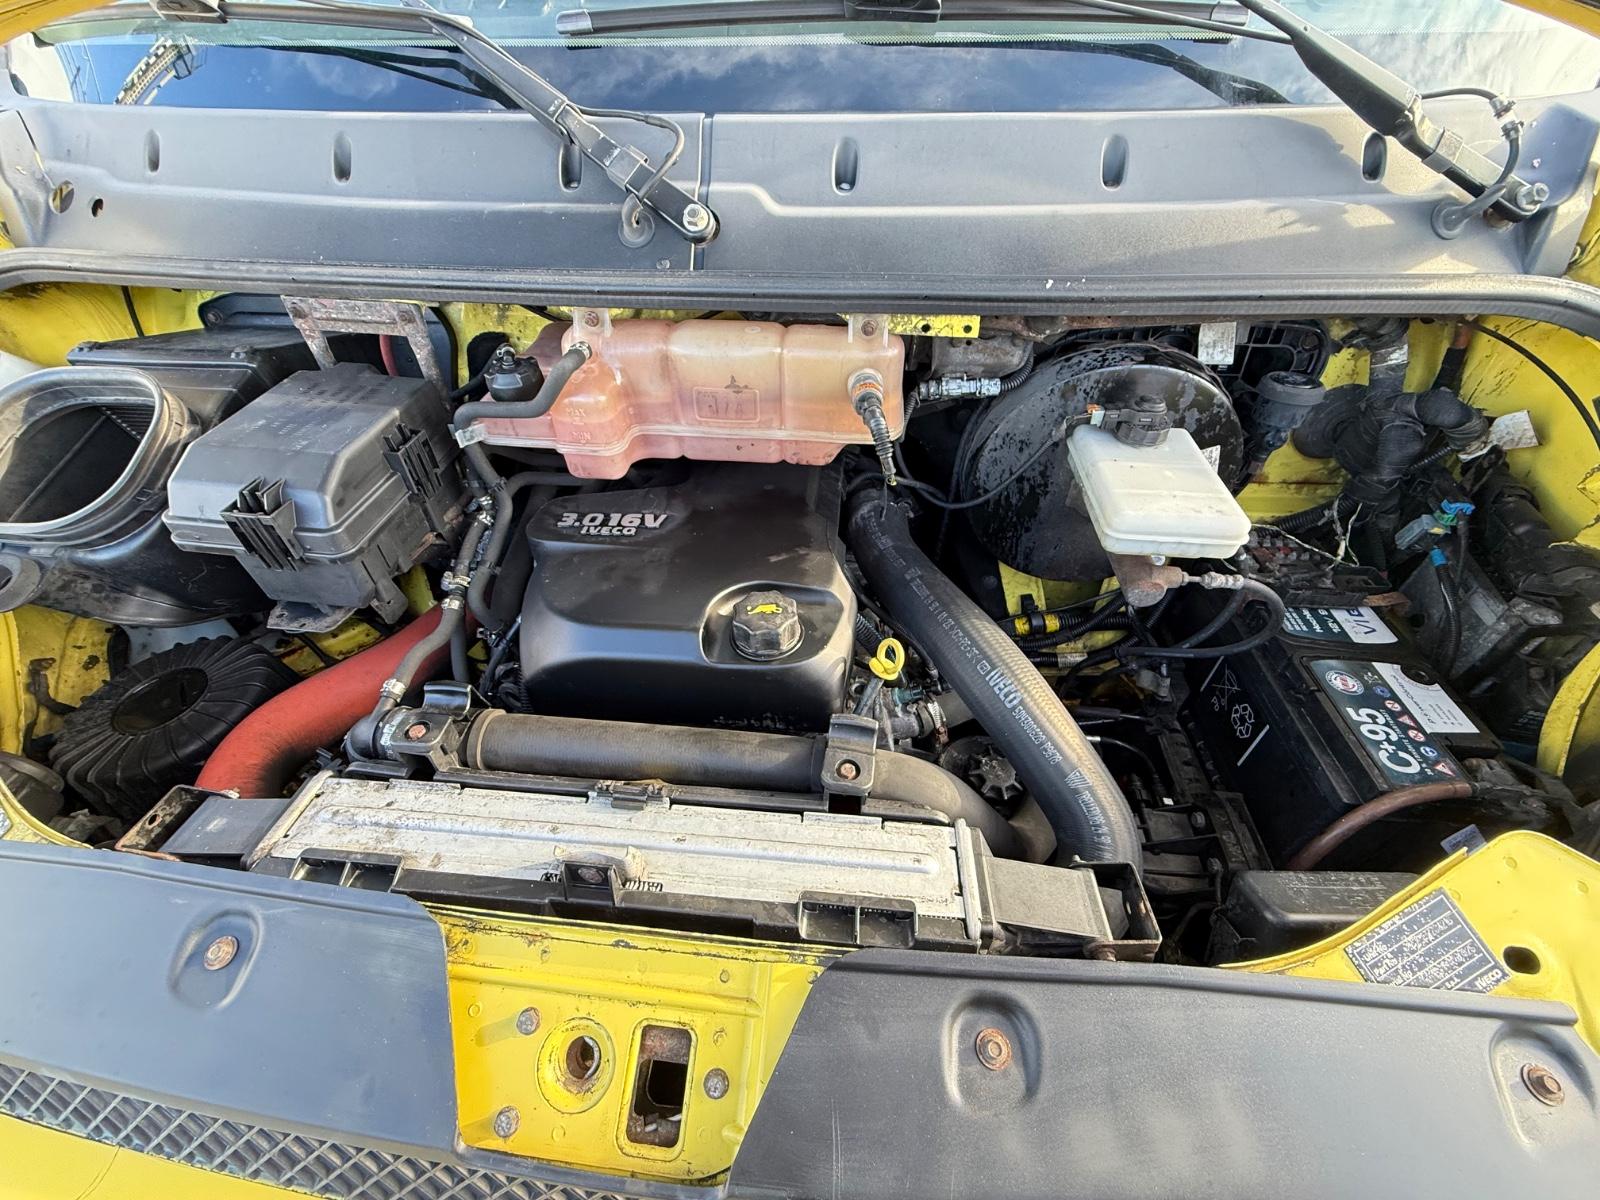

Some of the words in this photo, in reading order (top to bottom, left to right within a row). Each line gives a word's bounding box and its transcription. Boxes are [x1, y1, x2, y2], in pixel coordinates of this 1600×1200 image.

[557, 512, 604, 528] 3.0
[608, 511, 667, 529] 16V
[580, 526, 637, 536] IVECO
[985, 666, 1023, 709] IVECO
[1346, 707, 1420, 774] C+95
[1475, 969, 1502, 990] IVECO
